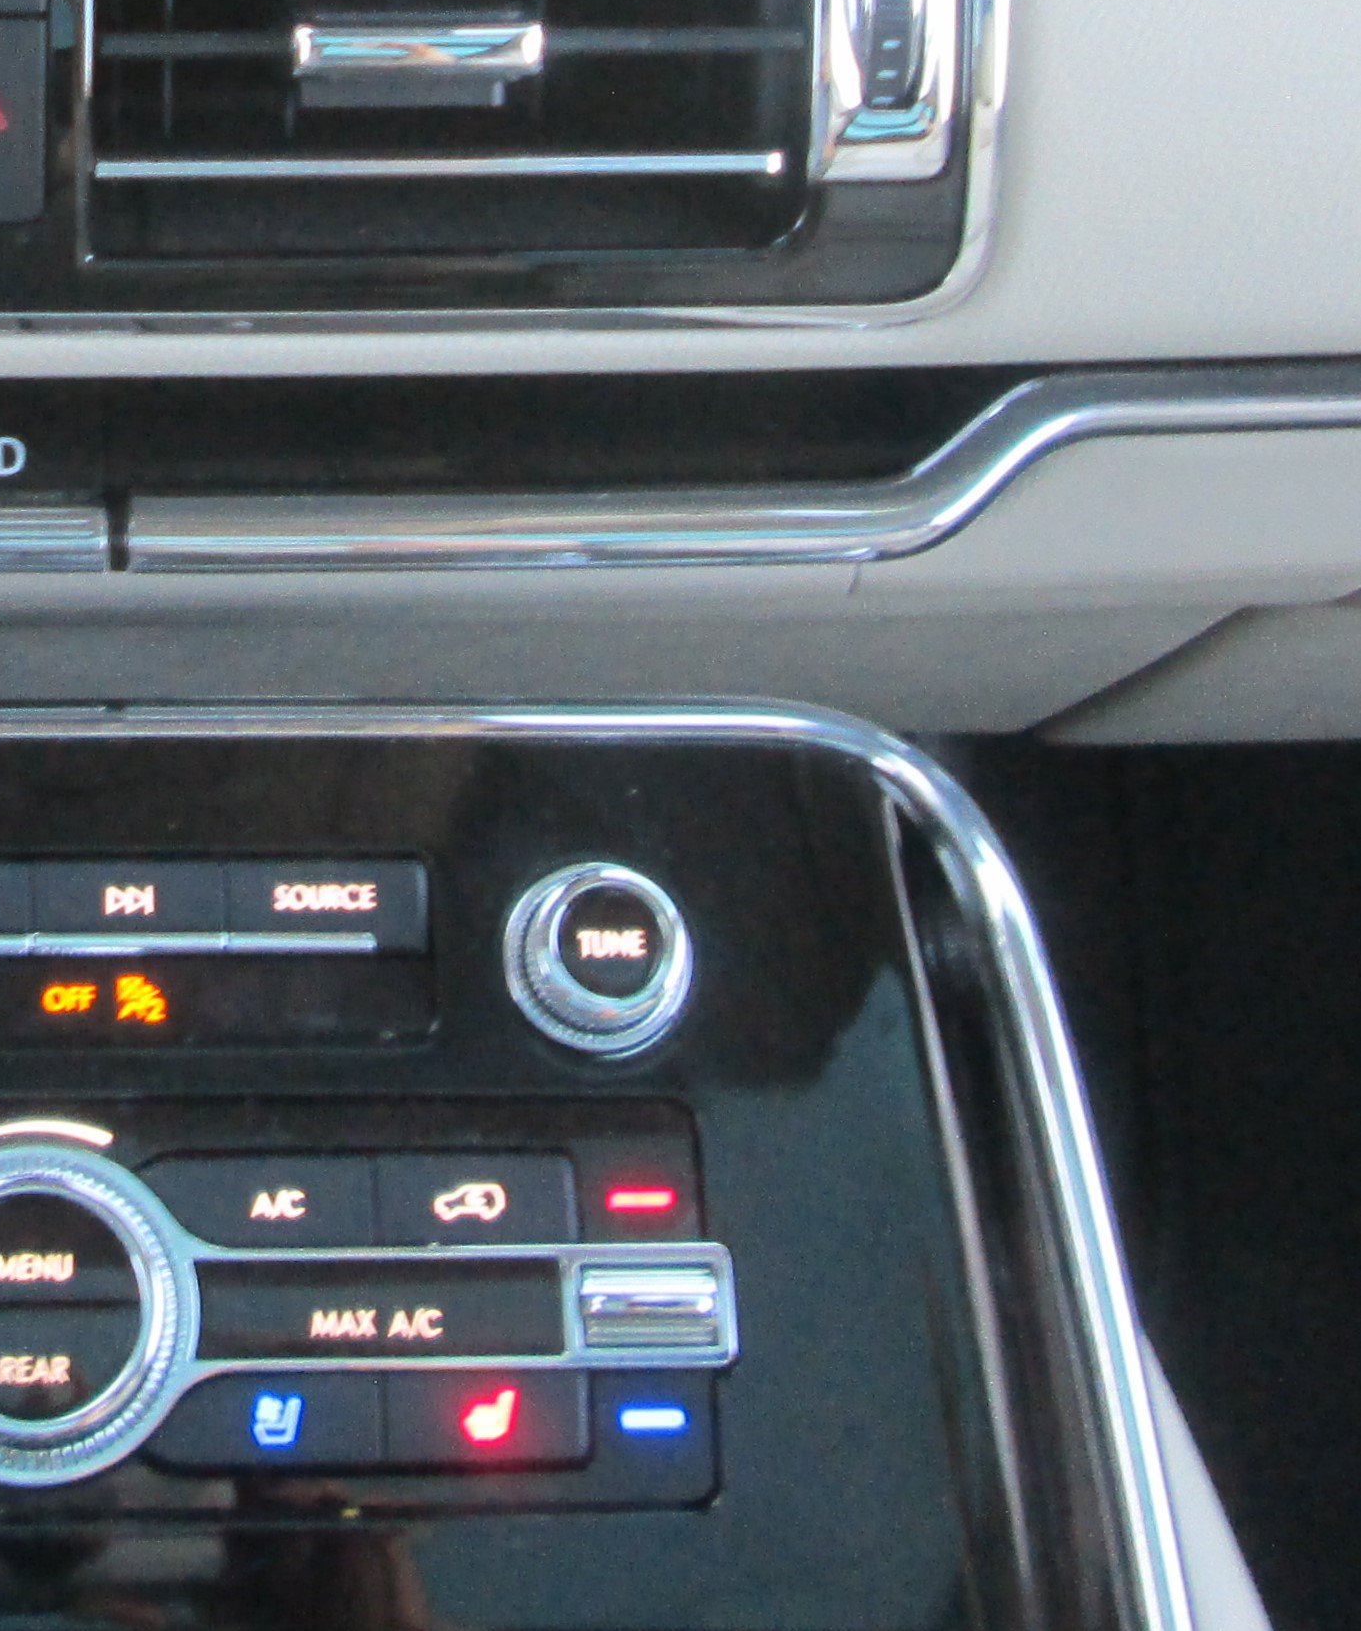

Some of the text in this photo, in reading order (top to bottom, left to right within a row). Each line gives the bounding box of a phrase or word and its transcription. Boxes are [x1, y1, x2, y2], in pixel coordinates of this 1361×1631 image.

[272, 883, 378, 913] SOURCE
[576, 929, 647, 959] TUNE
[42, 983, 96, 1013] OFF
[250, 1188, 306, 1220] A/C
[310, 1308, 444, 1339] MAX A/C
